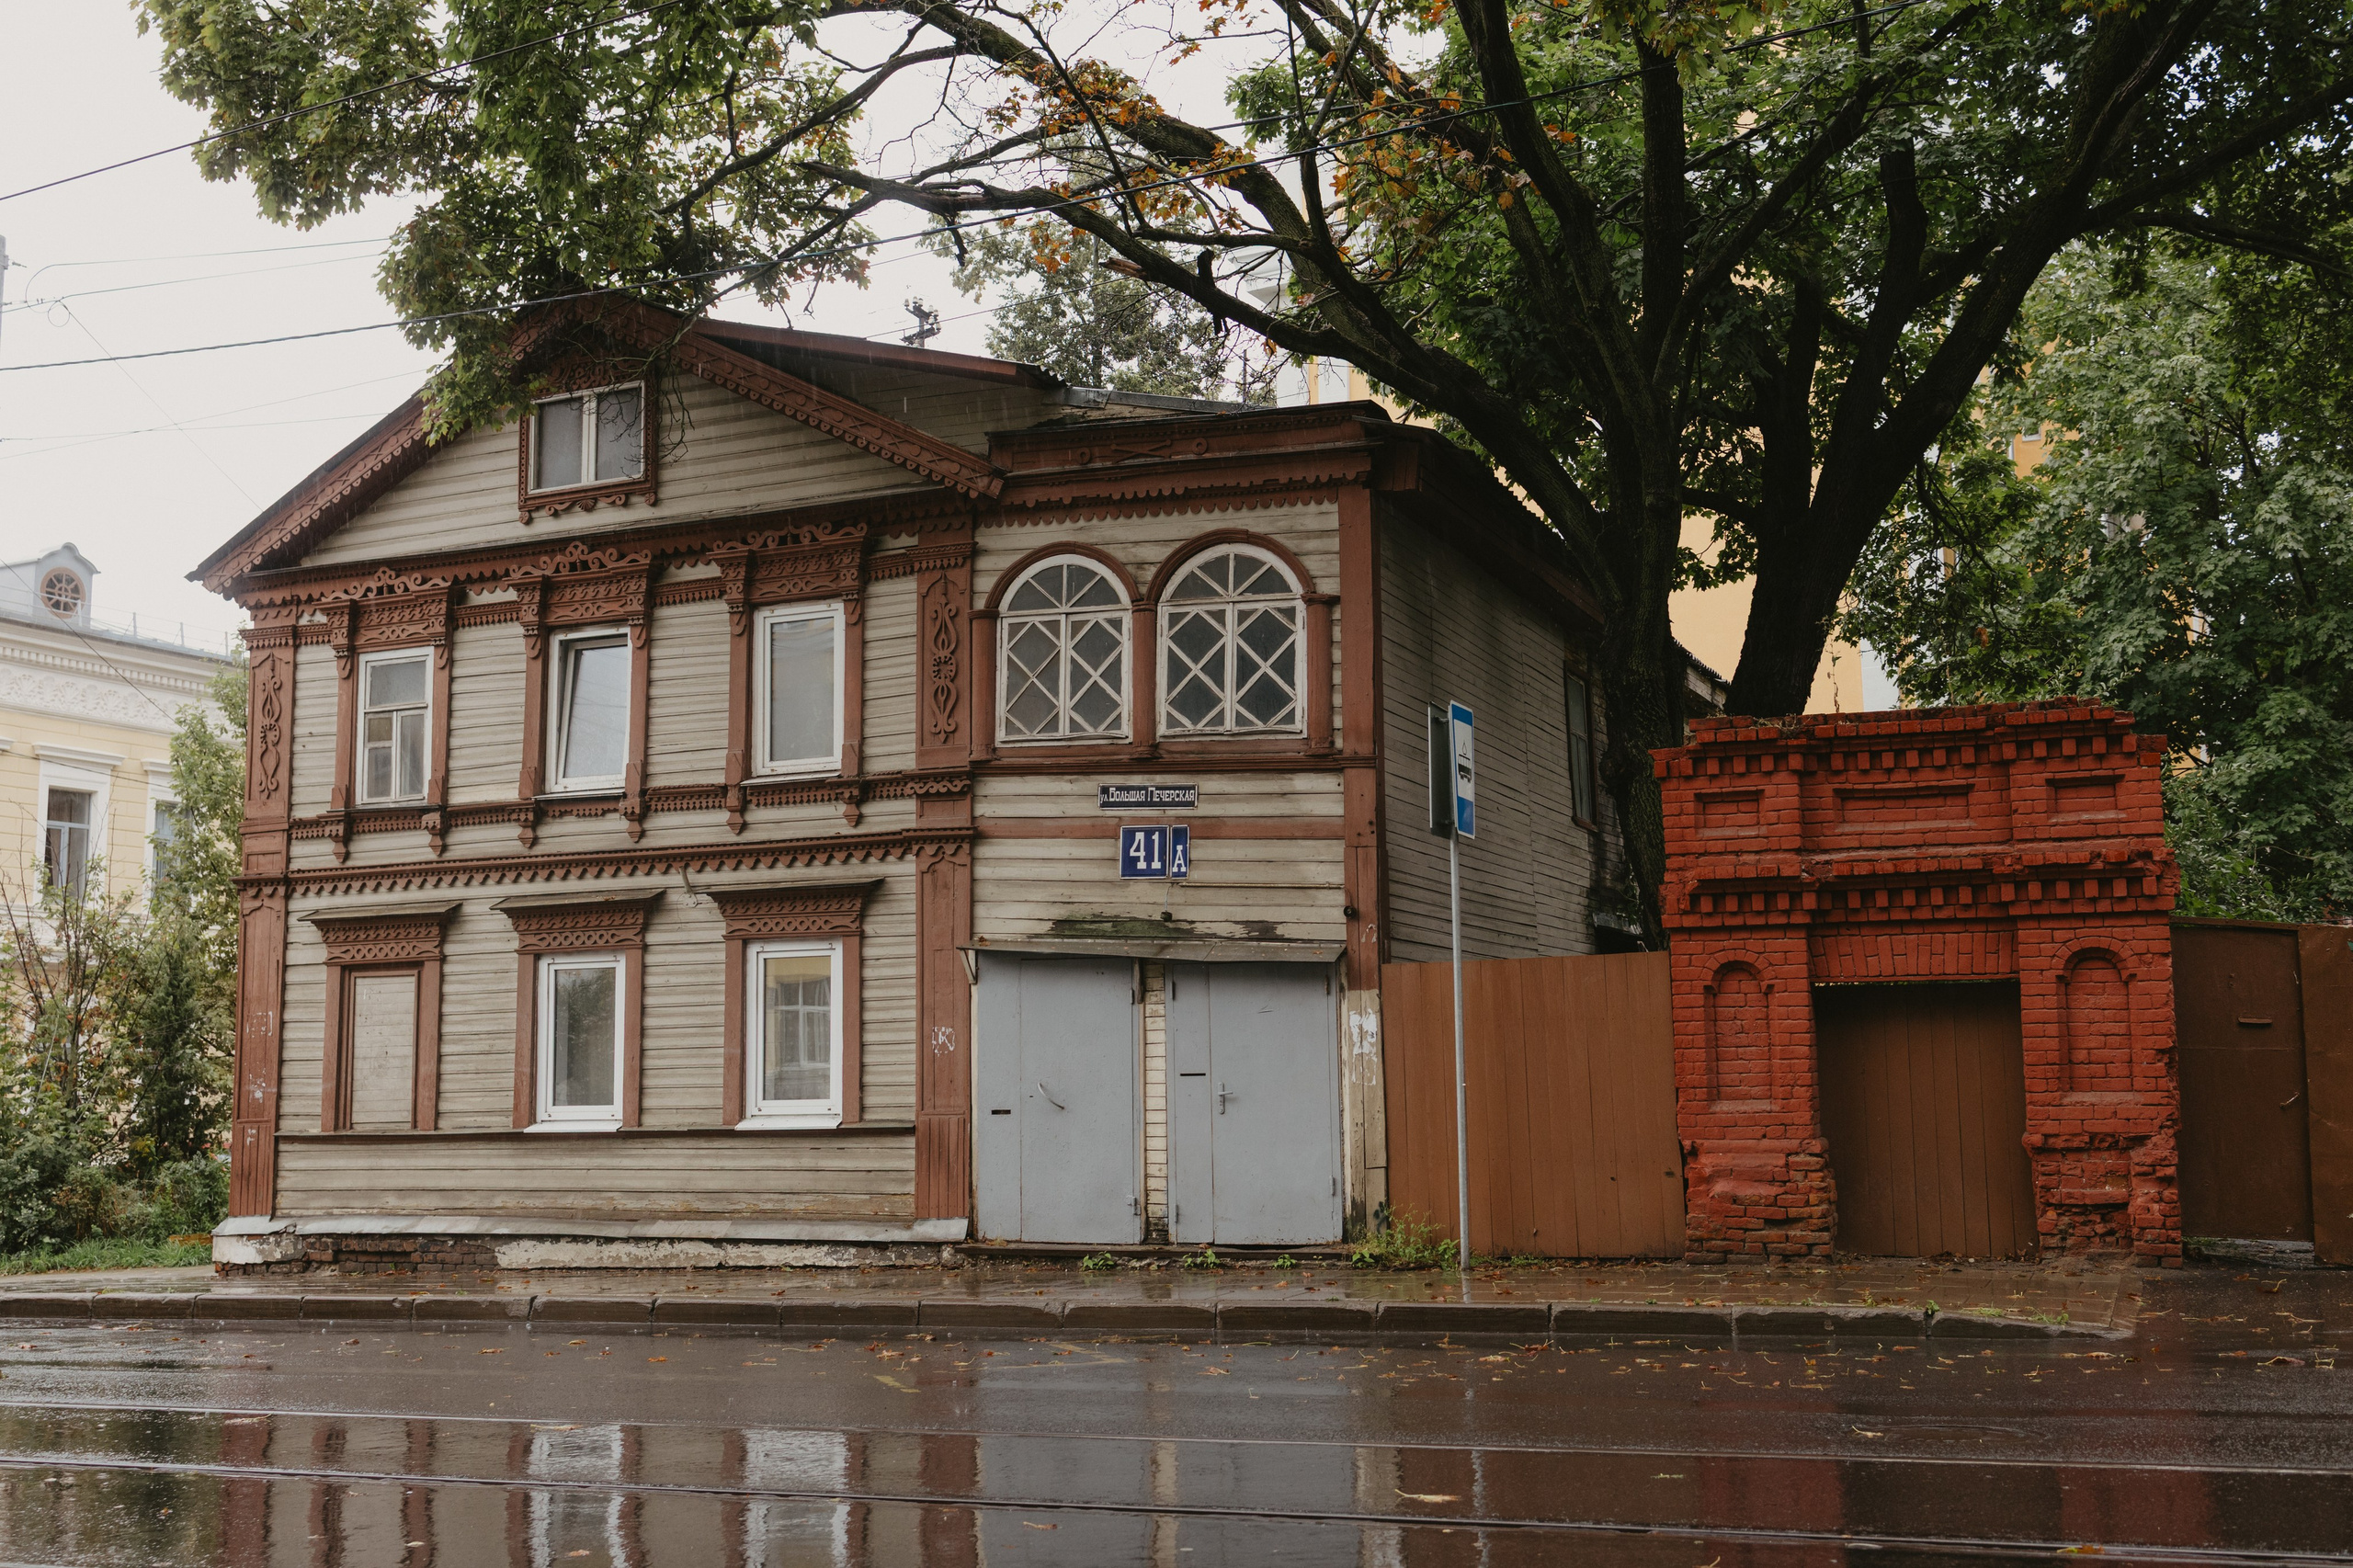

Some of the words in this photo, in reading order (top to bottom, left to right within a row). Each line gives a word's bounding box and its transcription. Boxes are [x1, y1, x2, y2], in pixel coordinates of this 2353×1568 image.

[1109, 788, 1145, 801] БОЛЬШАЯ
[1148, 788, 1195, 801] ПЕЧЕРСКАЯ
[1130, 832, 1161, 869] 41
[1173, 845, 1186, 871] А
